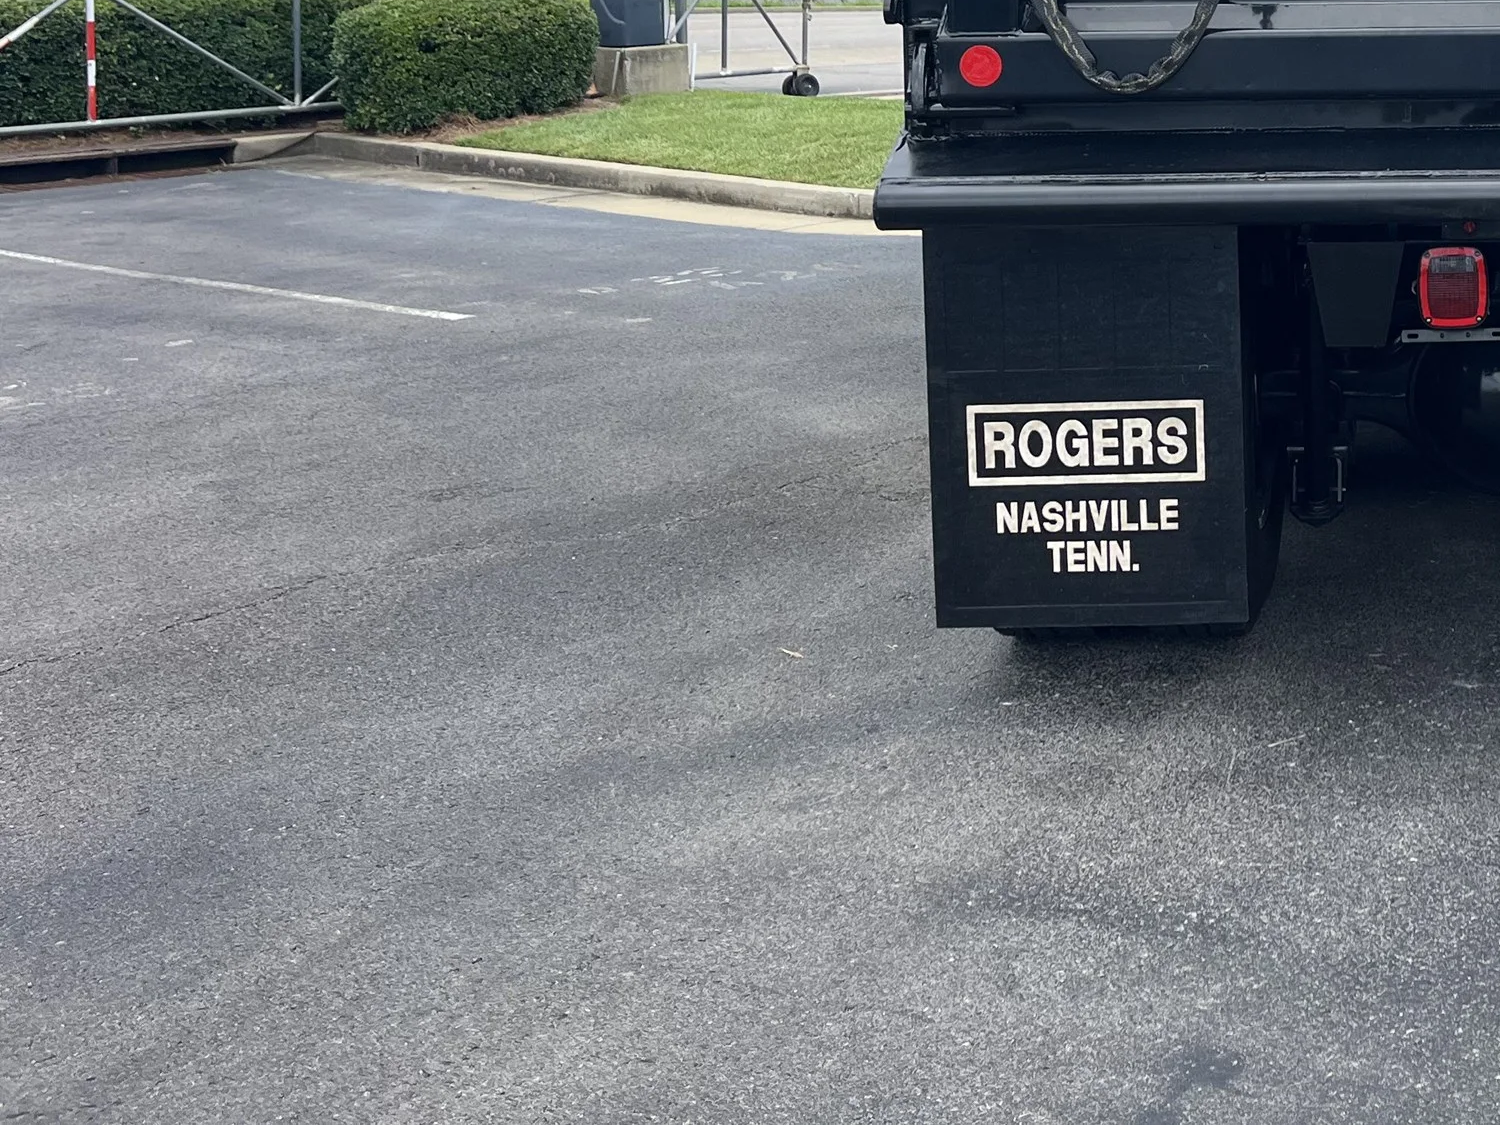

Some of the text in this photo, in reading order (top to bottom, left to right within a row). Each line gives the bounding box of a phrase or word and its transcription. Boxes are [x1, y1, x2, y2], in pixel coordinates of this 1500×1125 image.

[983, 416, 1188, 469] ROGERS
[996, 498, 1179, 534] NASHVILLE
[1047, 540, 1140, 573] TENN.
